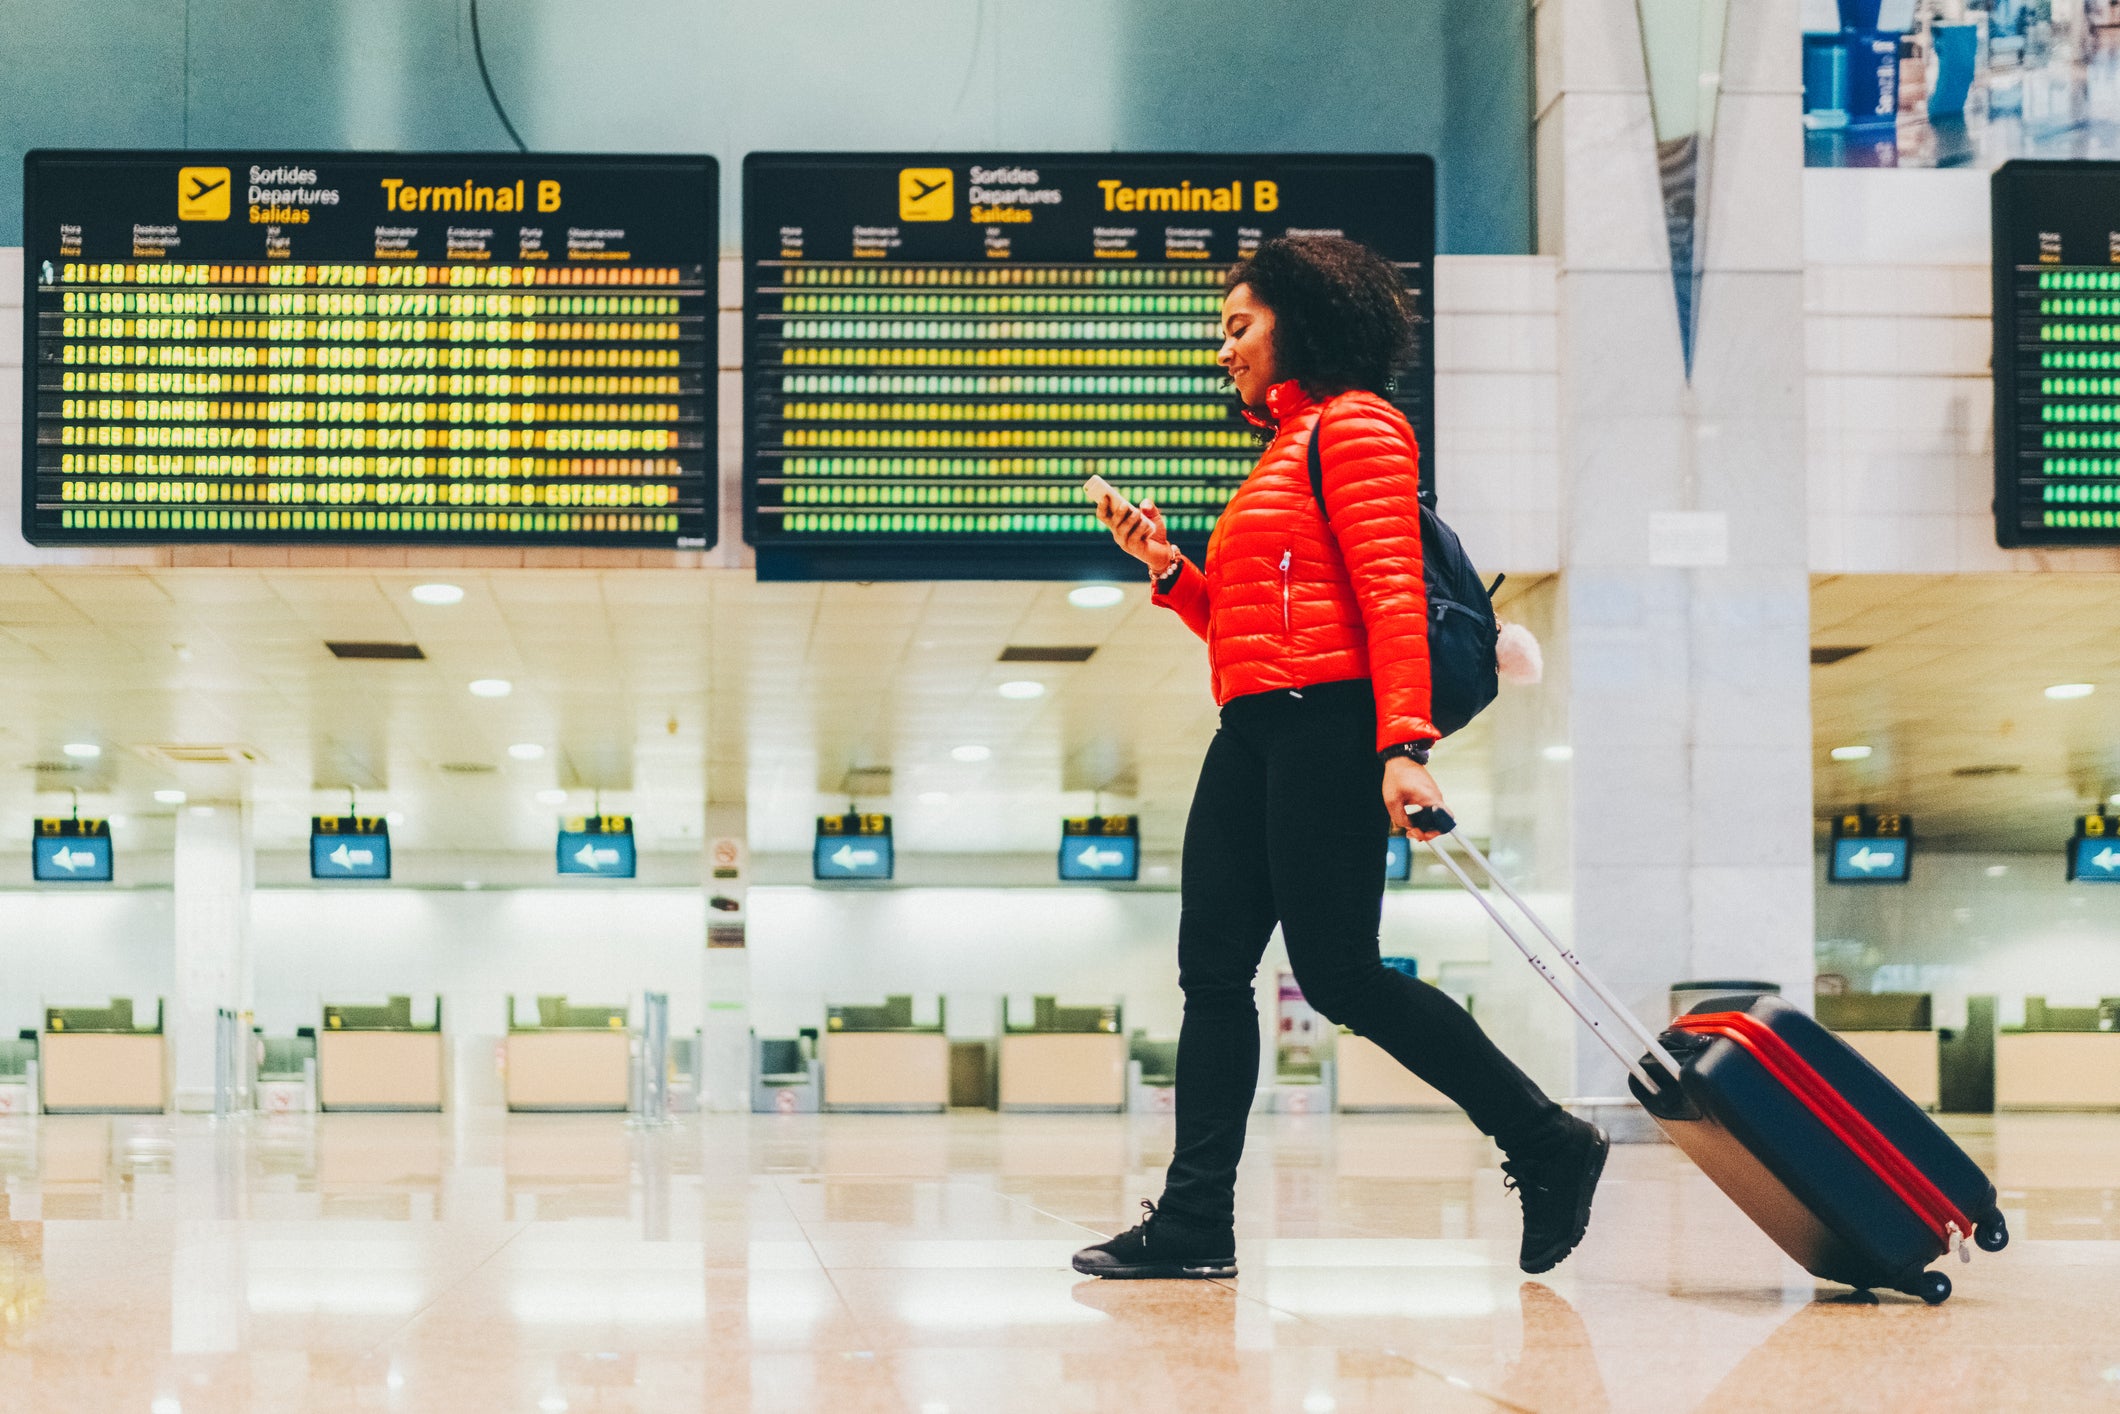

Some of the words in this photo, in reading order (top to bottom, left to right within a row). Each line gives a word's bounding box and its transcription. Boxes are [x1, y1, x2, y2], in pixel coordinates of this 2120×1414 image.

[249, 165, 317, 185] Sortides
[970, 166, 1039, 185] Sortides
[248, 186, 339, 207] Departures
[381, 178, 524, 212] Terminal
[537, 179, 562, 213] B
[969, 186, 1062, 206] Departures
[1097, 180, 1242, 212] Terminal
[1254, 180, 1278, 213] B
[249, 205, 310, 224] Salidas
[970, 206, 1033, 224] Salidas
[64, 264, 124, 284] 21:20
[136, 264, 209, 284] SKOPJE
[63, 293, 124, 313] 21:30
[136, 293, 221, 313] BOLONIA
[63, 318, 124, 338] 21:30
[136, 318, 197, 338] SOFIA
[63, 346, 124, 365] 21:35
[136, 346, 257, 366] P.MALLORCA
[63, 373, 123, 392] 21:55
[135, 373, 220, 393] SEVILLA
[63, 400, 123, 420] 21:55
[135, 400, 208, 420] GDANSK
[63, 427, 123, 446] 21:55
[62, 454, 123, 474] 21:55
[135, 454, 183, 474] CLUJ
[195, 455, 256, 474] NAPOC
[62, 482, 123, 501] 22:20
[135, 482, 208, 502] OPORTO
